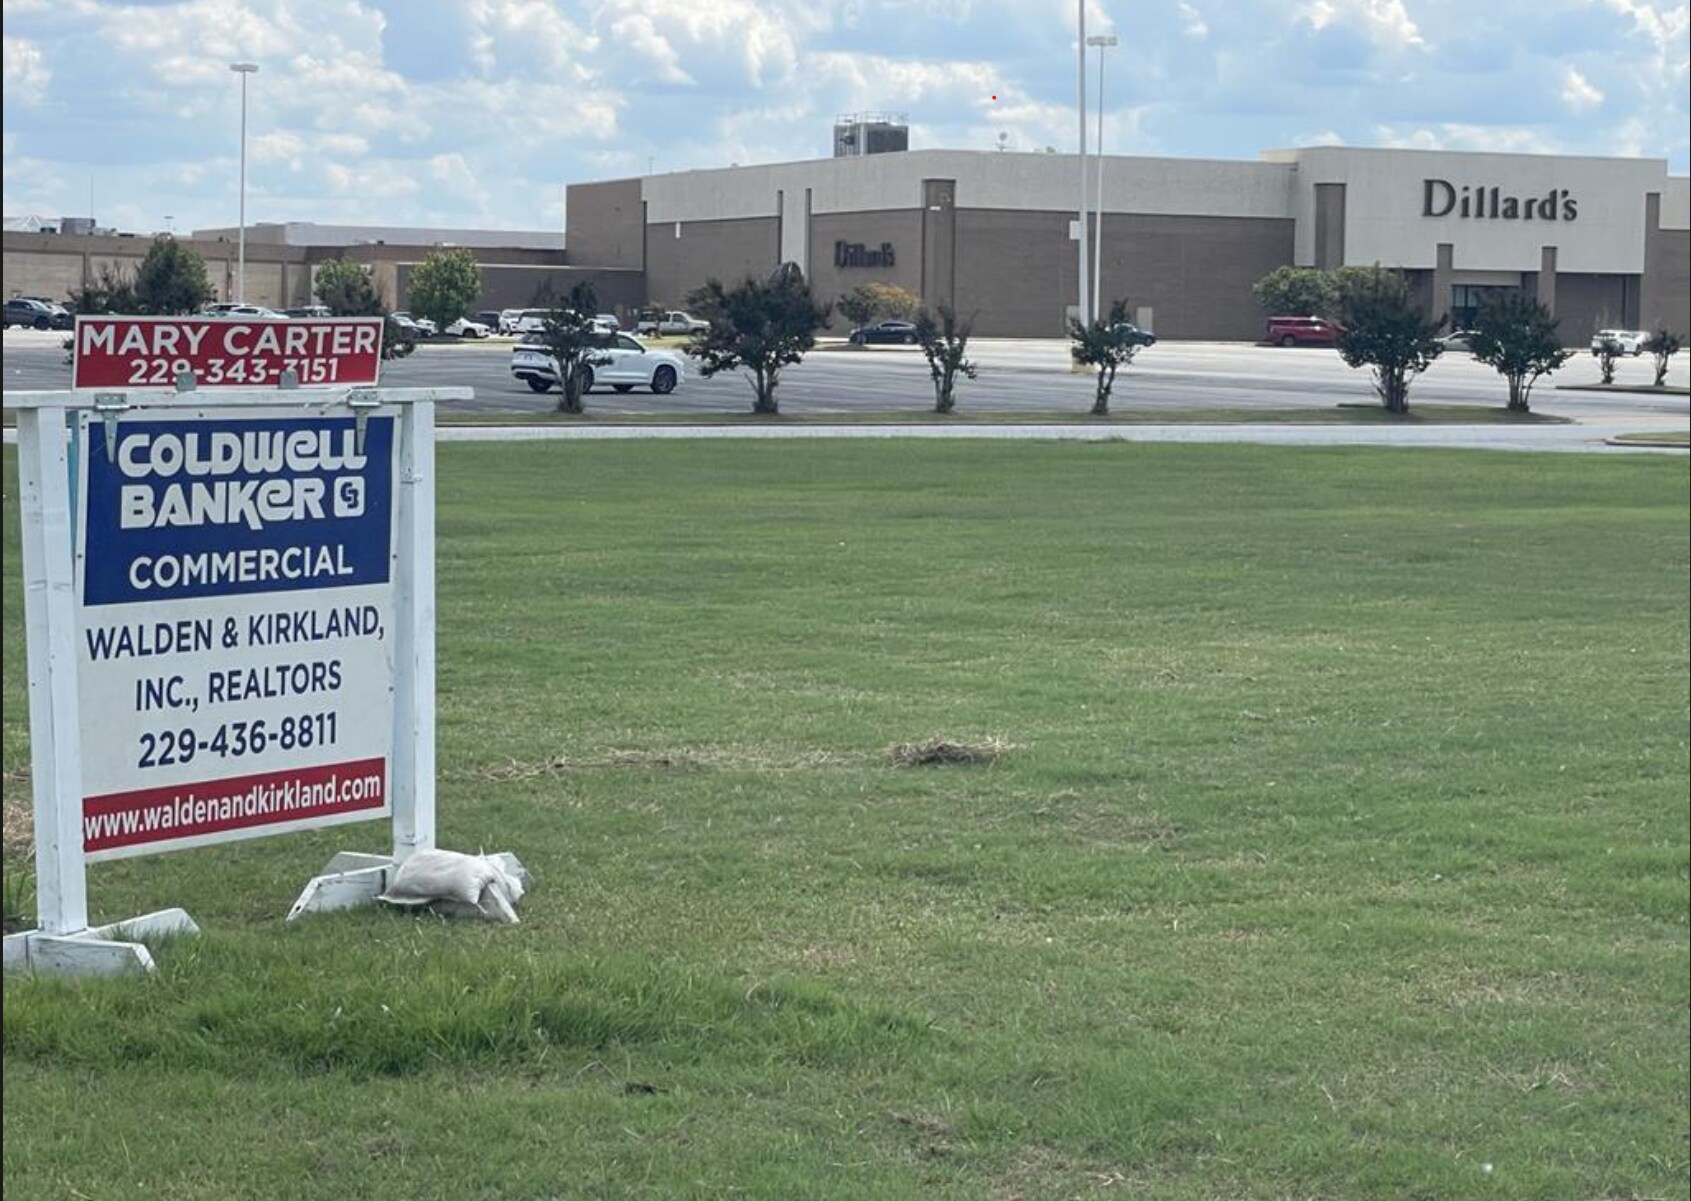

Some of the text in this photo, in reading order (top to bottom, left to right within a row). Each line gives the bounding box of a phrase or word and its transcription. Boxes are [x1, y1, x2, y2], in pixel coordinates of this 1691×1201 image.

[1422, 178, 1578, 221] Dillard's
[82, 324, 376, 356] MARY CARTER
[129, 544, 354, 590] COMMERCIAL
[86, 605, 385, 661] WALDEN & KIRKLAND,
[136, 660, 342, 712] INC., REALTORS
[138, 712, 337, 769] 229-436-8811
[84, 774, 381, 841] www.waldenandkirkland.com
